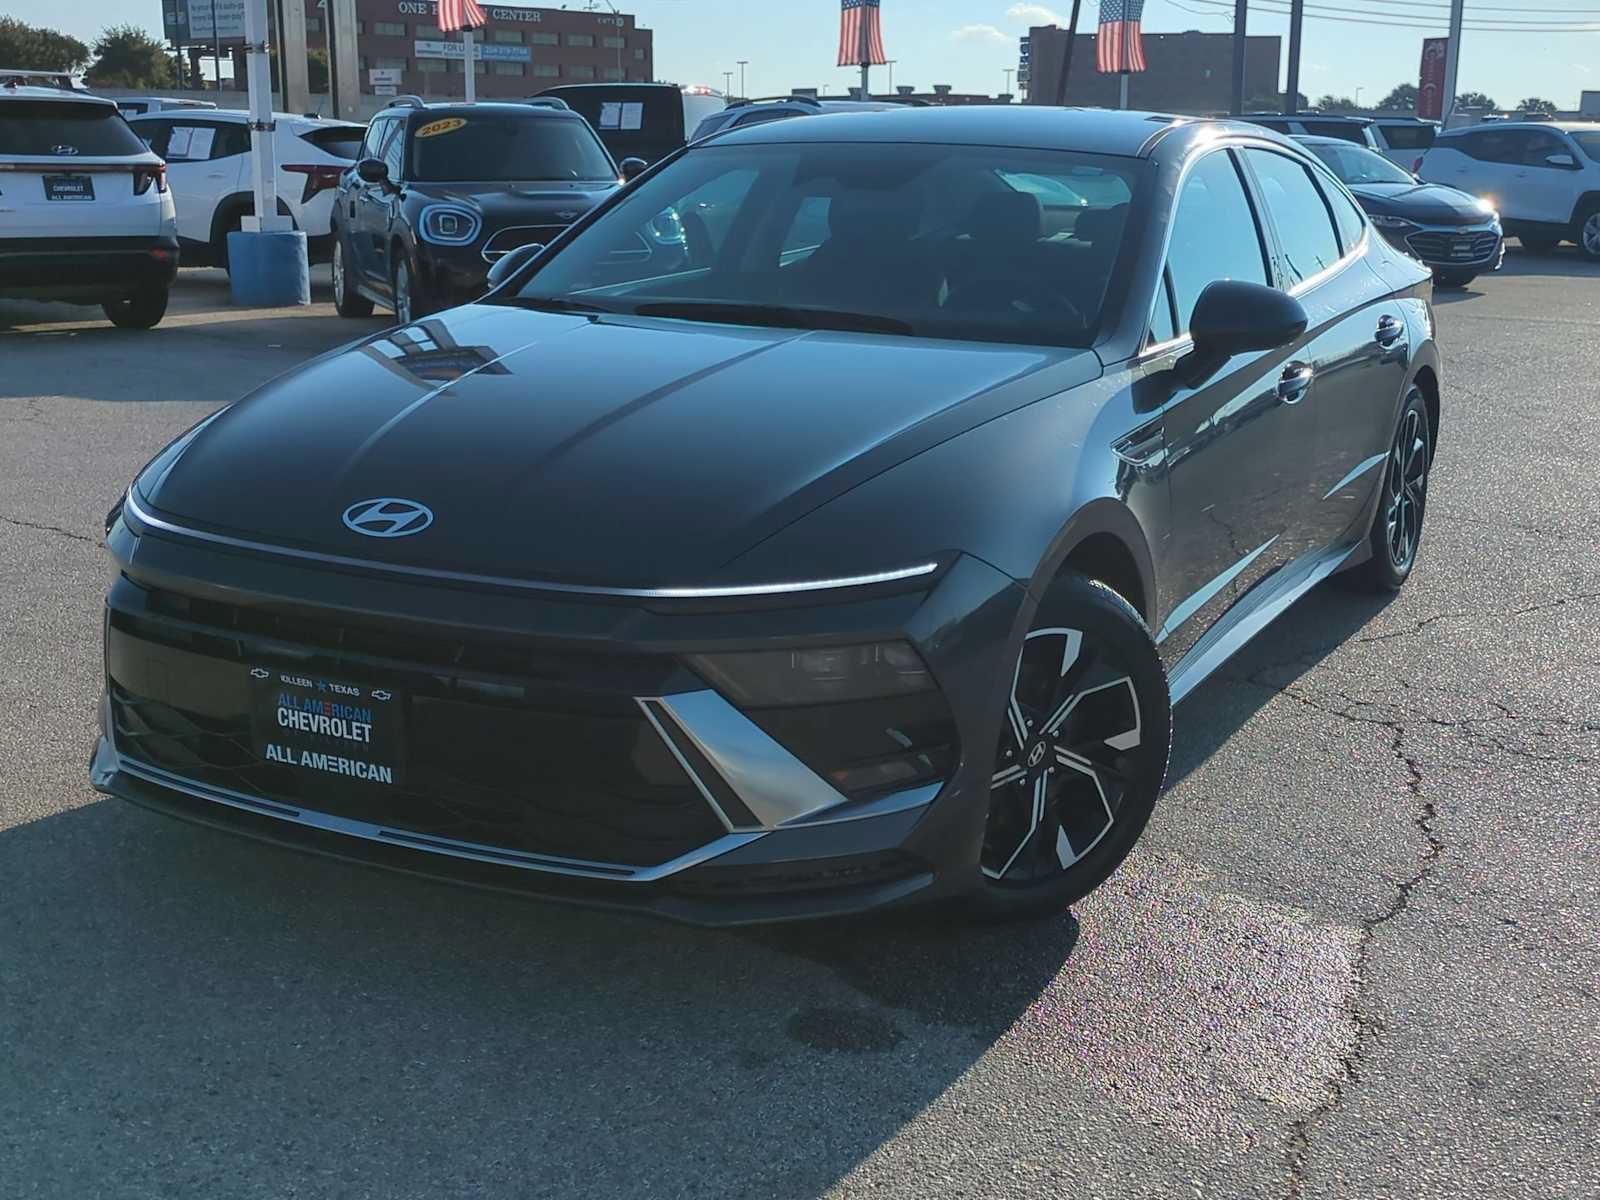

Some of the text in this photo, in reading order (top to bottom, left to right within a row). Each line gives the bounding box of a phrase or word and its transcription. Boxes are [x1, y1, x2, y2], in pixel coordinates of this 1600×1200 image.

[398, 2, 427, 15] ONE
[493, 8, 541, 22] CENTER
[421, 119, 461, 136] 2023
[280, 674, 361, 696] KILLEEN TEXAS
[277, 693, 372, 723] ALL AMERICAN
[277, 707, 372, 743] CHEVROLET
[266, 743, 393, 784] ALL AMERICAN
